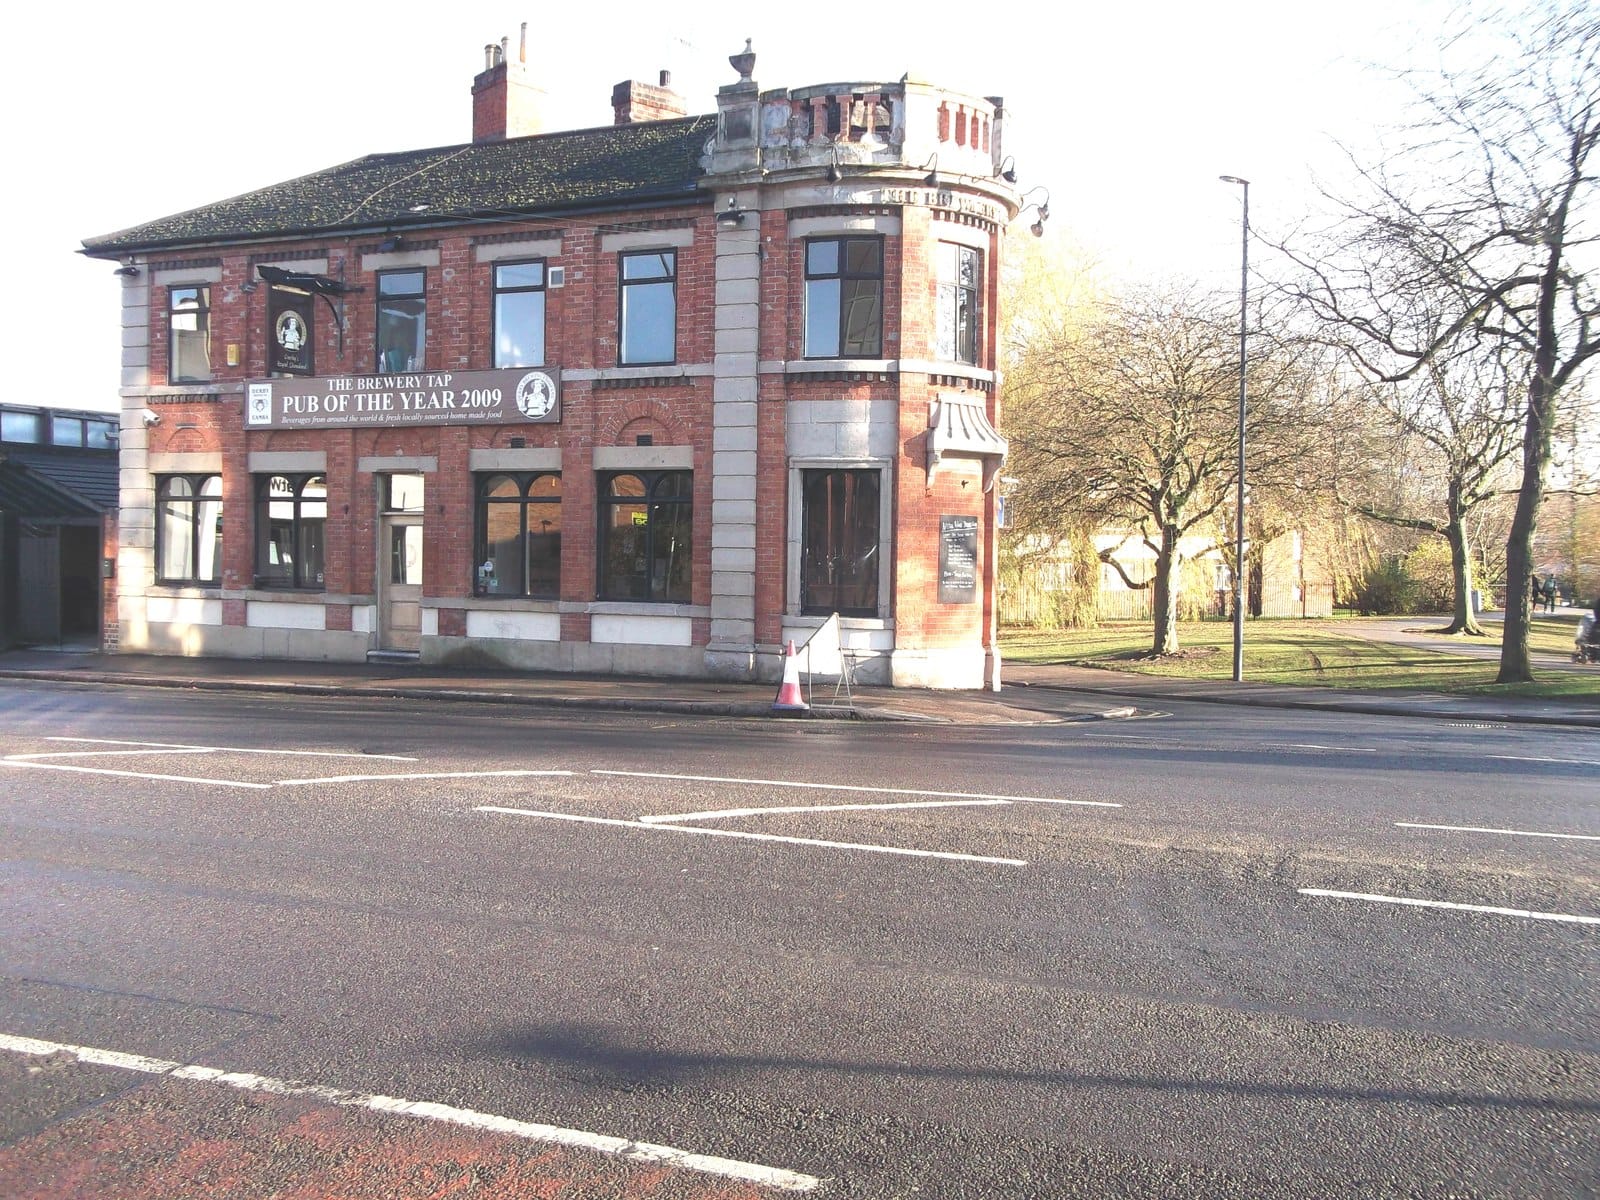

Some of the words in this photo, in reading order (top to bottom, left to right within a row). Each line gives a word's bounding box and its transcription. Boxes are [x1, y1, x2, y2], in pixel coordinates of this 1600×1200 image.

[327, 378, 354, 391] THE
[357, 375, 423, 390] BREWERY
[426, 374, 452, 388] TAP
[283, 394, 319, 413] PUB
[323, 394, 350, 412] OF
[354, 393, 394, 411] THE
[399, 390, 456, 410] YEAR
[461, 388, 502, 408] 2009
[281, 415, 311, 424] Beverages
[311, 415, 326, 424] from
[327, 415, 349, 423] around
[349, 414, 359, 422] the
[360, 413, 379, 422] world
[379, 413, 385, 421] &
[385, 413, 402, 422] fresh
[402, 412, 423, 421] locally
[424, 411, 450, 420] sourced
[450, 411, 467, 419] home
[469, 410, 486, 419] made
[486, 410, 503, 420] food
